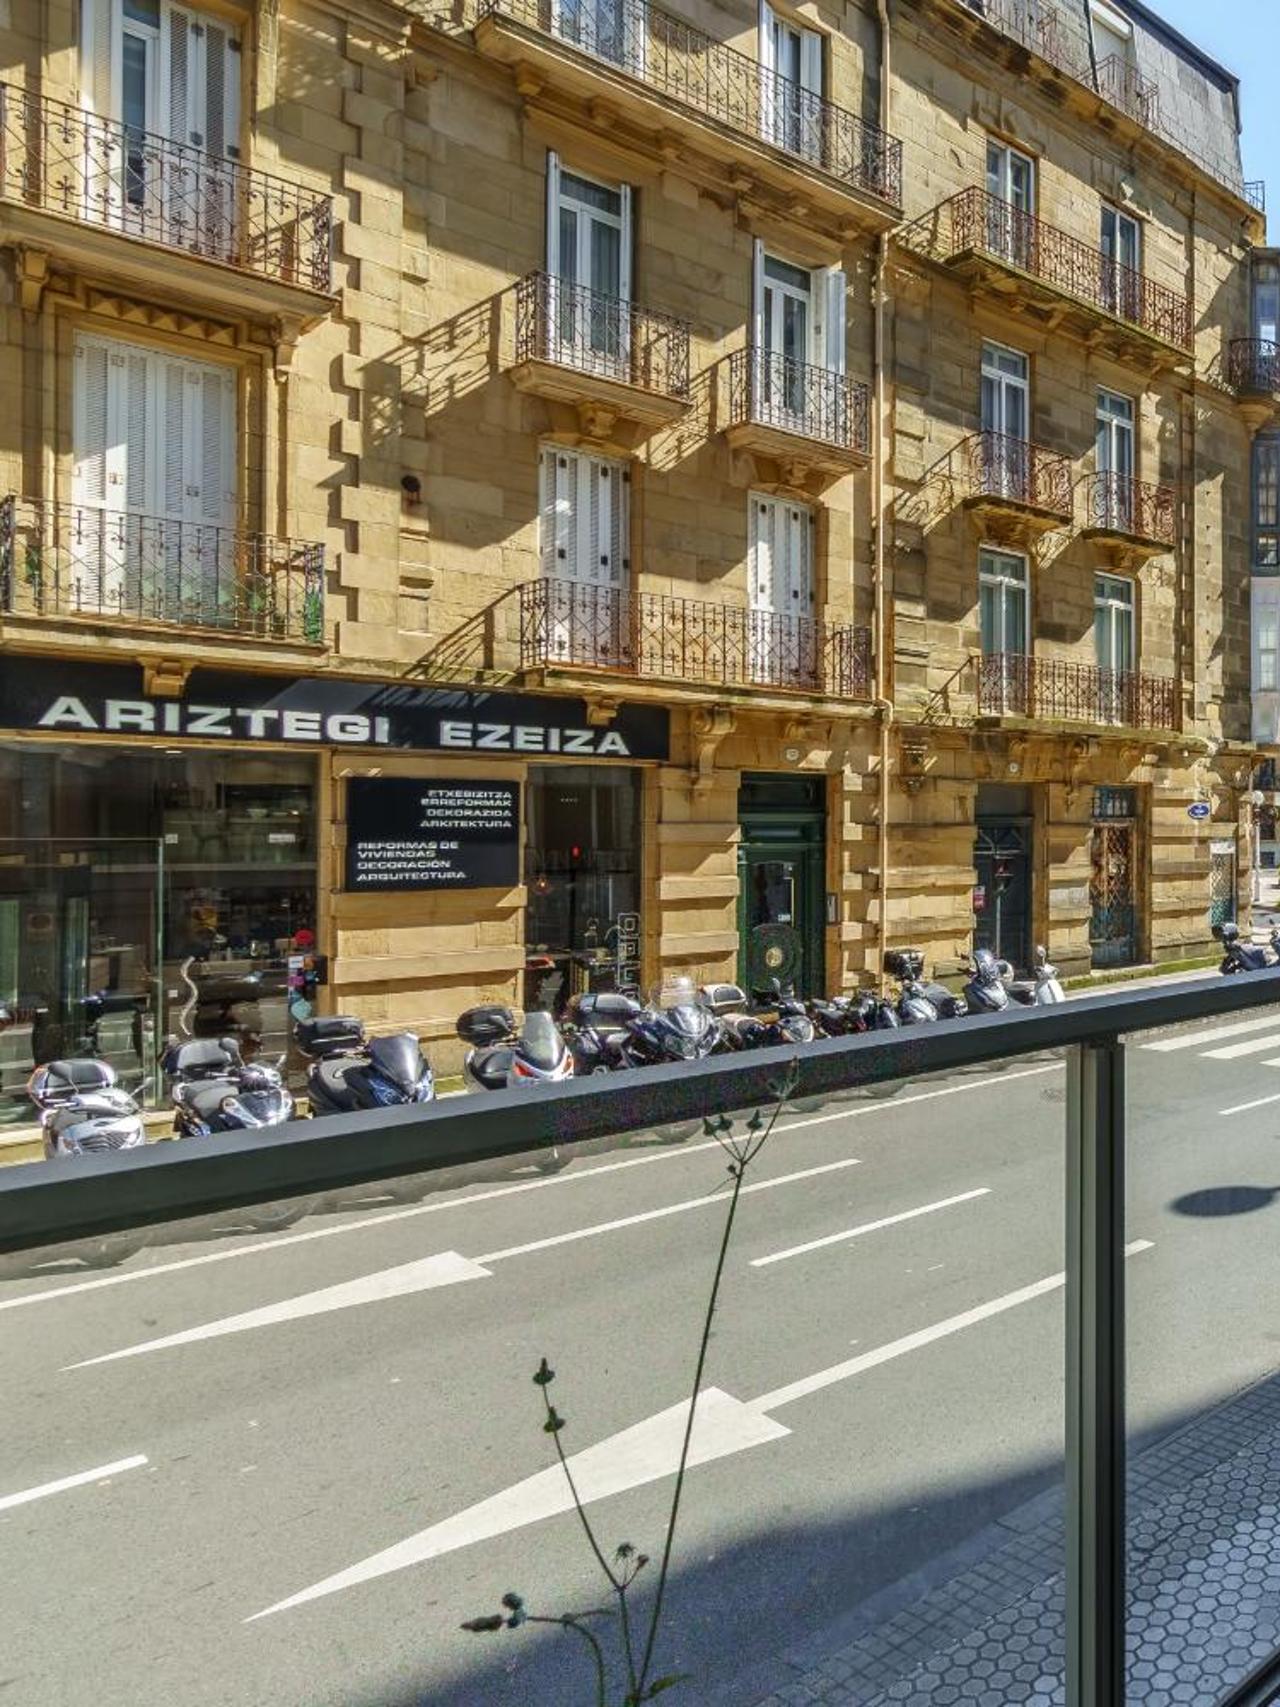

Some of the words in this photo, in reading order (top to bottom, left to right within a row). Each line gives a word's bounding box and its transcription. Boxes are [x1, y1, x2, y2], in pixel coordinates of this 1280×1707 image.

[37, 695, 389, 743] ARIZTEGI
[439, 720, 631, 756] EZEIZA
[427, 789, 512, 799] ETXEBIZITZA
[420, 798, 512, 807] ERREFORMAK
[426, 808, 512, 817] DEKORAZIOA
[420, 820, 512, 828] ARKITEKTURA
[357, 841, 438, 850] REFORMAS
[439, 841, 459, 849] DE
[357, 849, 437, 858] VIVIENDAS
[357, 860, 451, 870] DECORACIÓN
[356, 871, 467, 882] ARQUITECTURA
